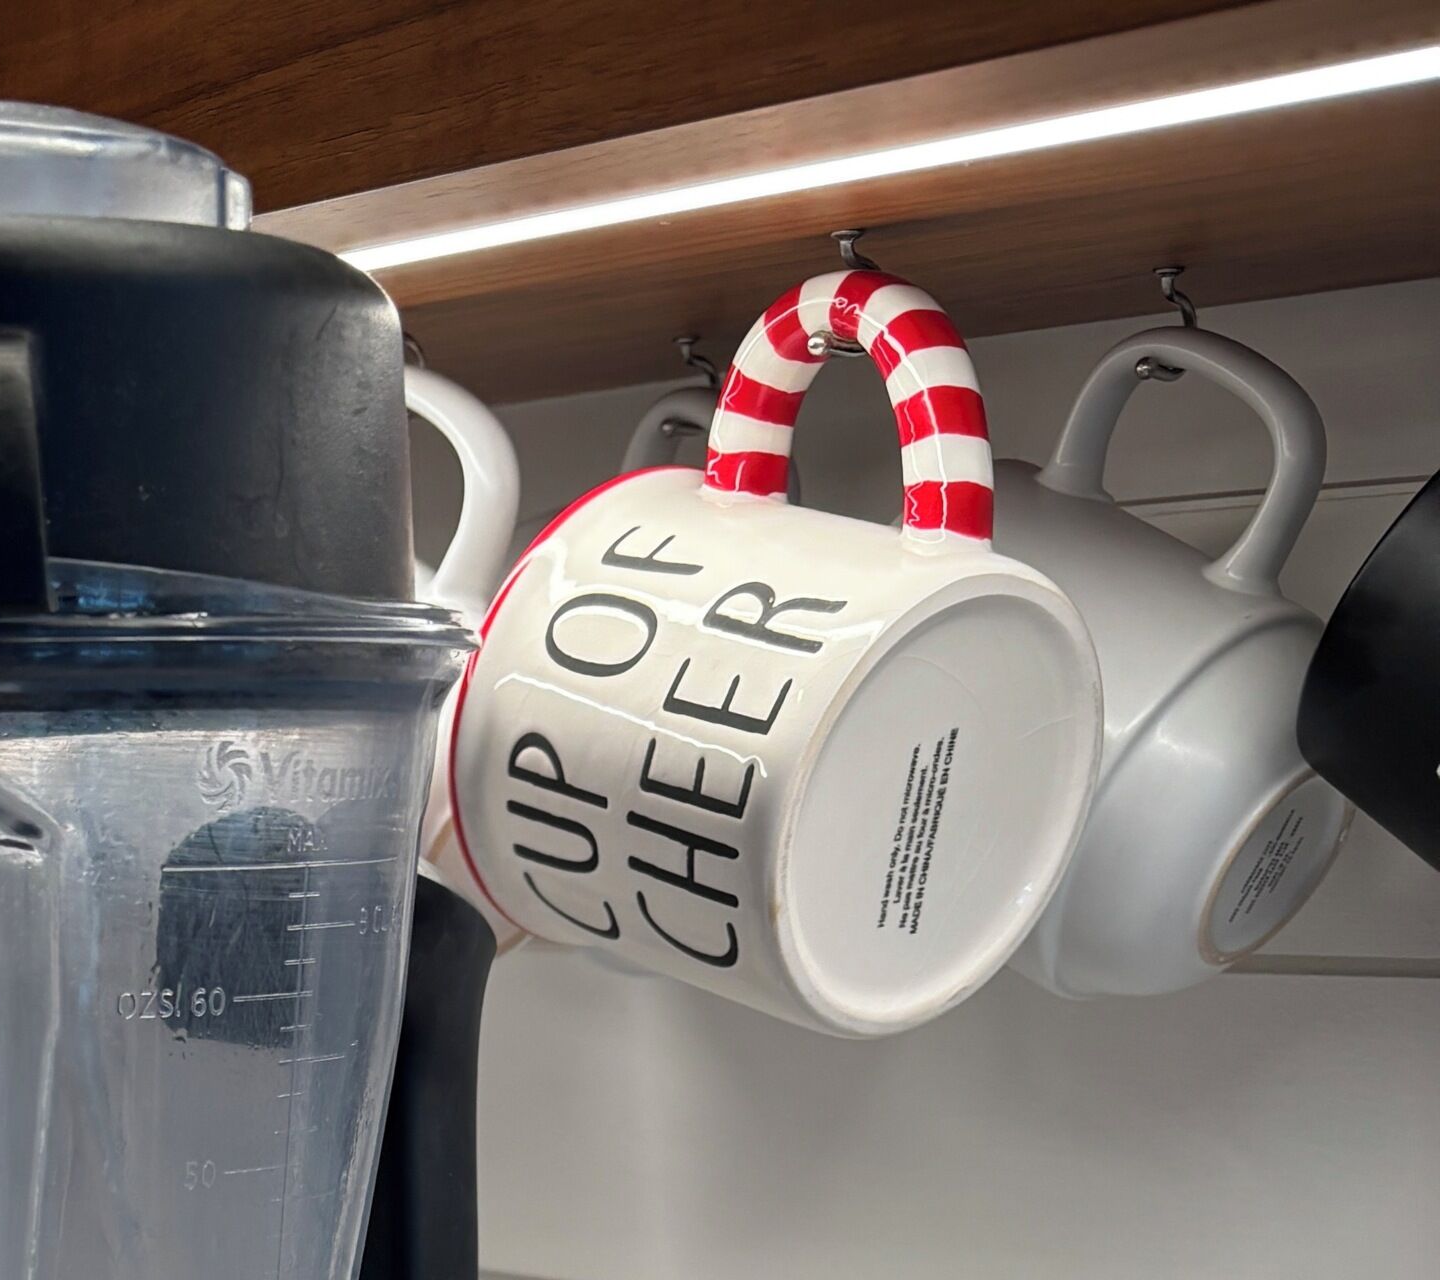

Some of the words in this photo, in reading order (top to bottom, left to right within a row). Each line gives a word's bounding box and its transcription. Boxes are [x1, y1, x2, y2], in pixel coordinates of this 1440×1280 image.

[544, 525, 704, 677] OF
[944, 728, 959, 765] CHINE
[260, 749, 396, 803] Vitamix
[626, 581, 848, 968] CHEER
[940, 767, 950, 785] EN
[506, 731, 620, 939] CUP
[917, 818, 927, 839] four
[914, 840, 923, 854] au
[877, 900, 888, 928] Hand
[884, 871, 894, 898] wash
[894, 826, 904, 841] Do
[900, 807, 908, 824] not
[893, 876, 904, 904] Laver
[900, 853, 910, 864] la
[905, 826, 916, 851] main
[906, 856, 919, 889] mettre
[903, 892, 912, 910] pas
[915, 887, 925, 899] IN
[899, 912, 908, 928] Ne
[909, 901, 922, 934] MADE
[191, 987, 225, 1017] 60
[183, 1159, 216, 1191] 50
